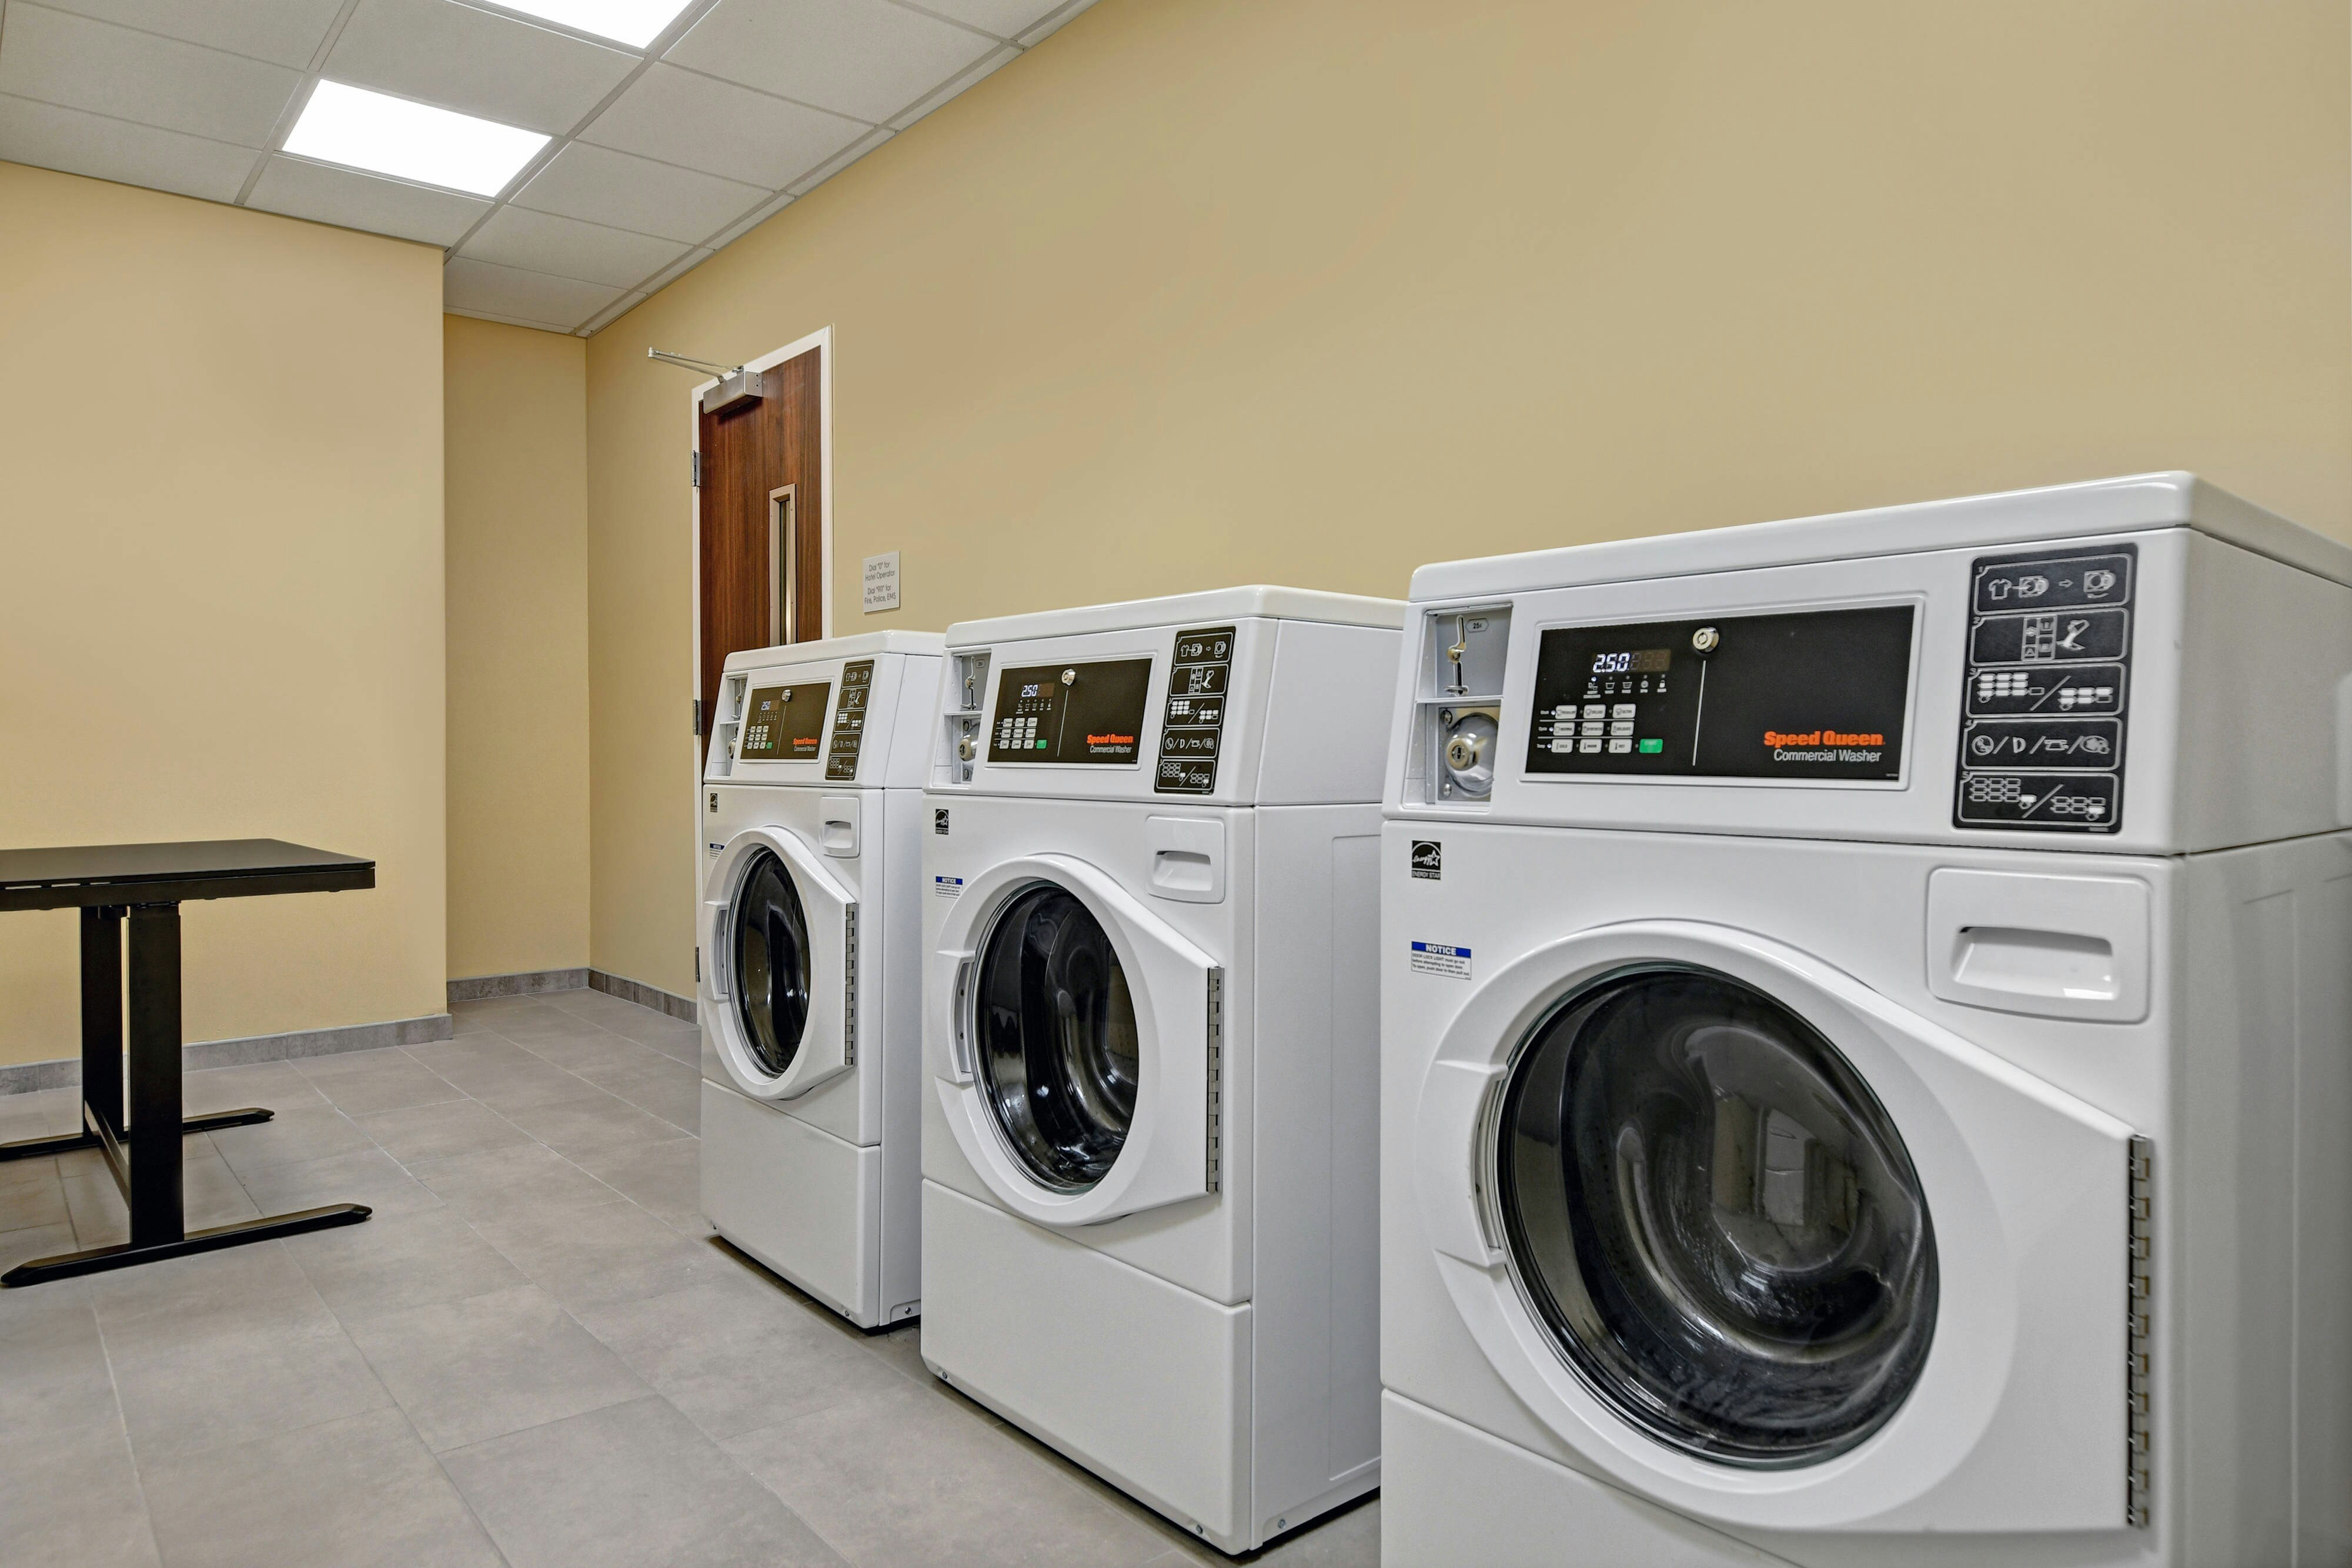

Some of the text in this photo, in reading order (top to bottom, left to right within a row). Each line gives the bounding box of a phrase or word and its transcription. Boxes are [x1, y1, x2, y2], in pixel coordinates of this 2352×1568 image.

[865, 570, 895, 581] Hotel Operator
[887, 592, 896, 601] EMS
[1592, 651, 1631, 673] 2.50
[1087, 734, 1134, 745] Speed Queen
[1764, 730, 1883, 748] Speed Queen
[1090, 745, 1132, 753] Commercial Washer
[1773, 748, 1882, 762] Commercial Washer
[1425, 944, 1456, 955] NOTICE
